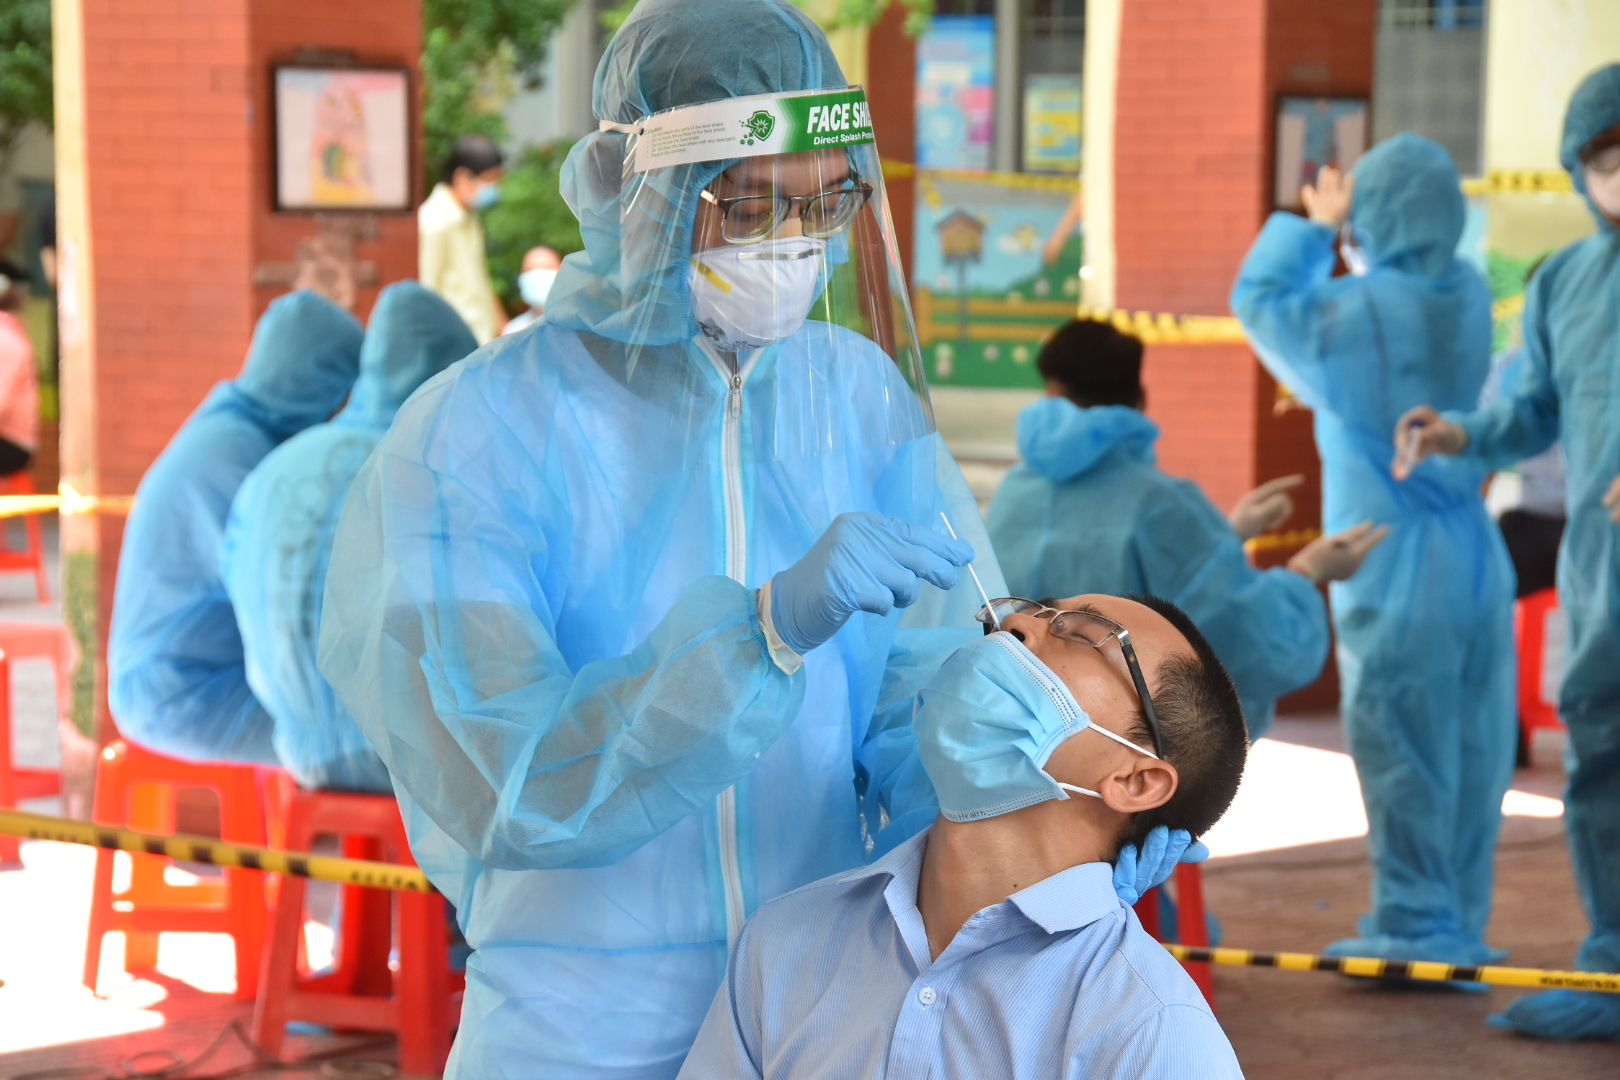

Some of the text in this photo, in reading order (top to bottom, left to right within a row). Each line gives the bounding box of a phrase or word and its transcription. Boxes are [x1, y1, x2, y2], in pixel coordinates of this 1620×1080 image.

[807, 103, 850, 133] FACE
[814, 135, 838, 144] Direct
[841, 132, 861, 142] Splash
[958, 810, 985, 820] Health
